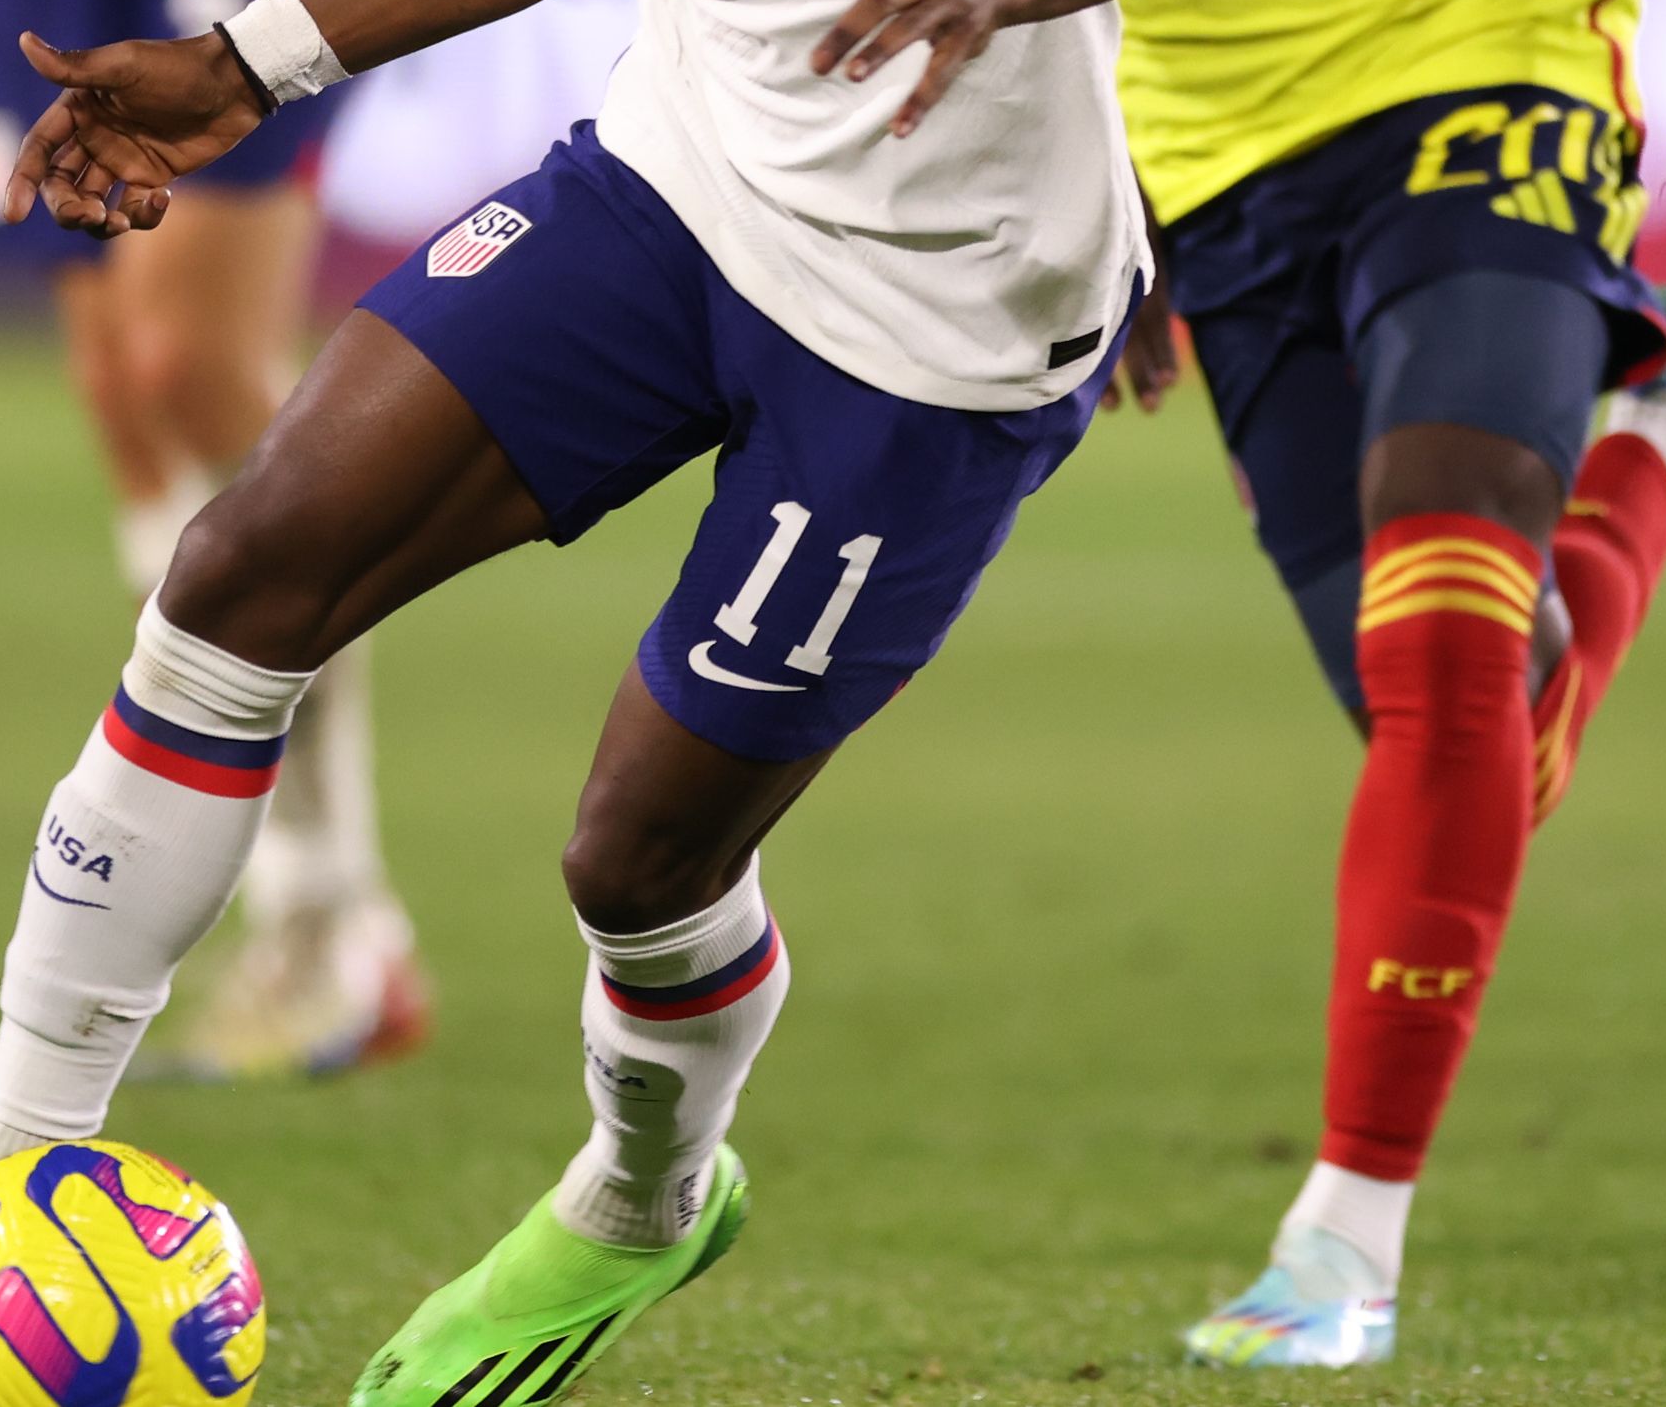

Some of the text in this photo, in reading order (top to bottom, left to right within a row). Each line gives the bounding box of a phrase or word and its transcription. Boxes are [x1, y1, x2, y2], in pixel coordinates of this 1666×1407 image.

[471, 204, 525, 242] USA
[712, 500, 884, 677] 11
[47, 813, 114, 883] USA
[1367, 956, 1475, 1000] FCF
